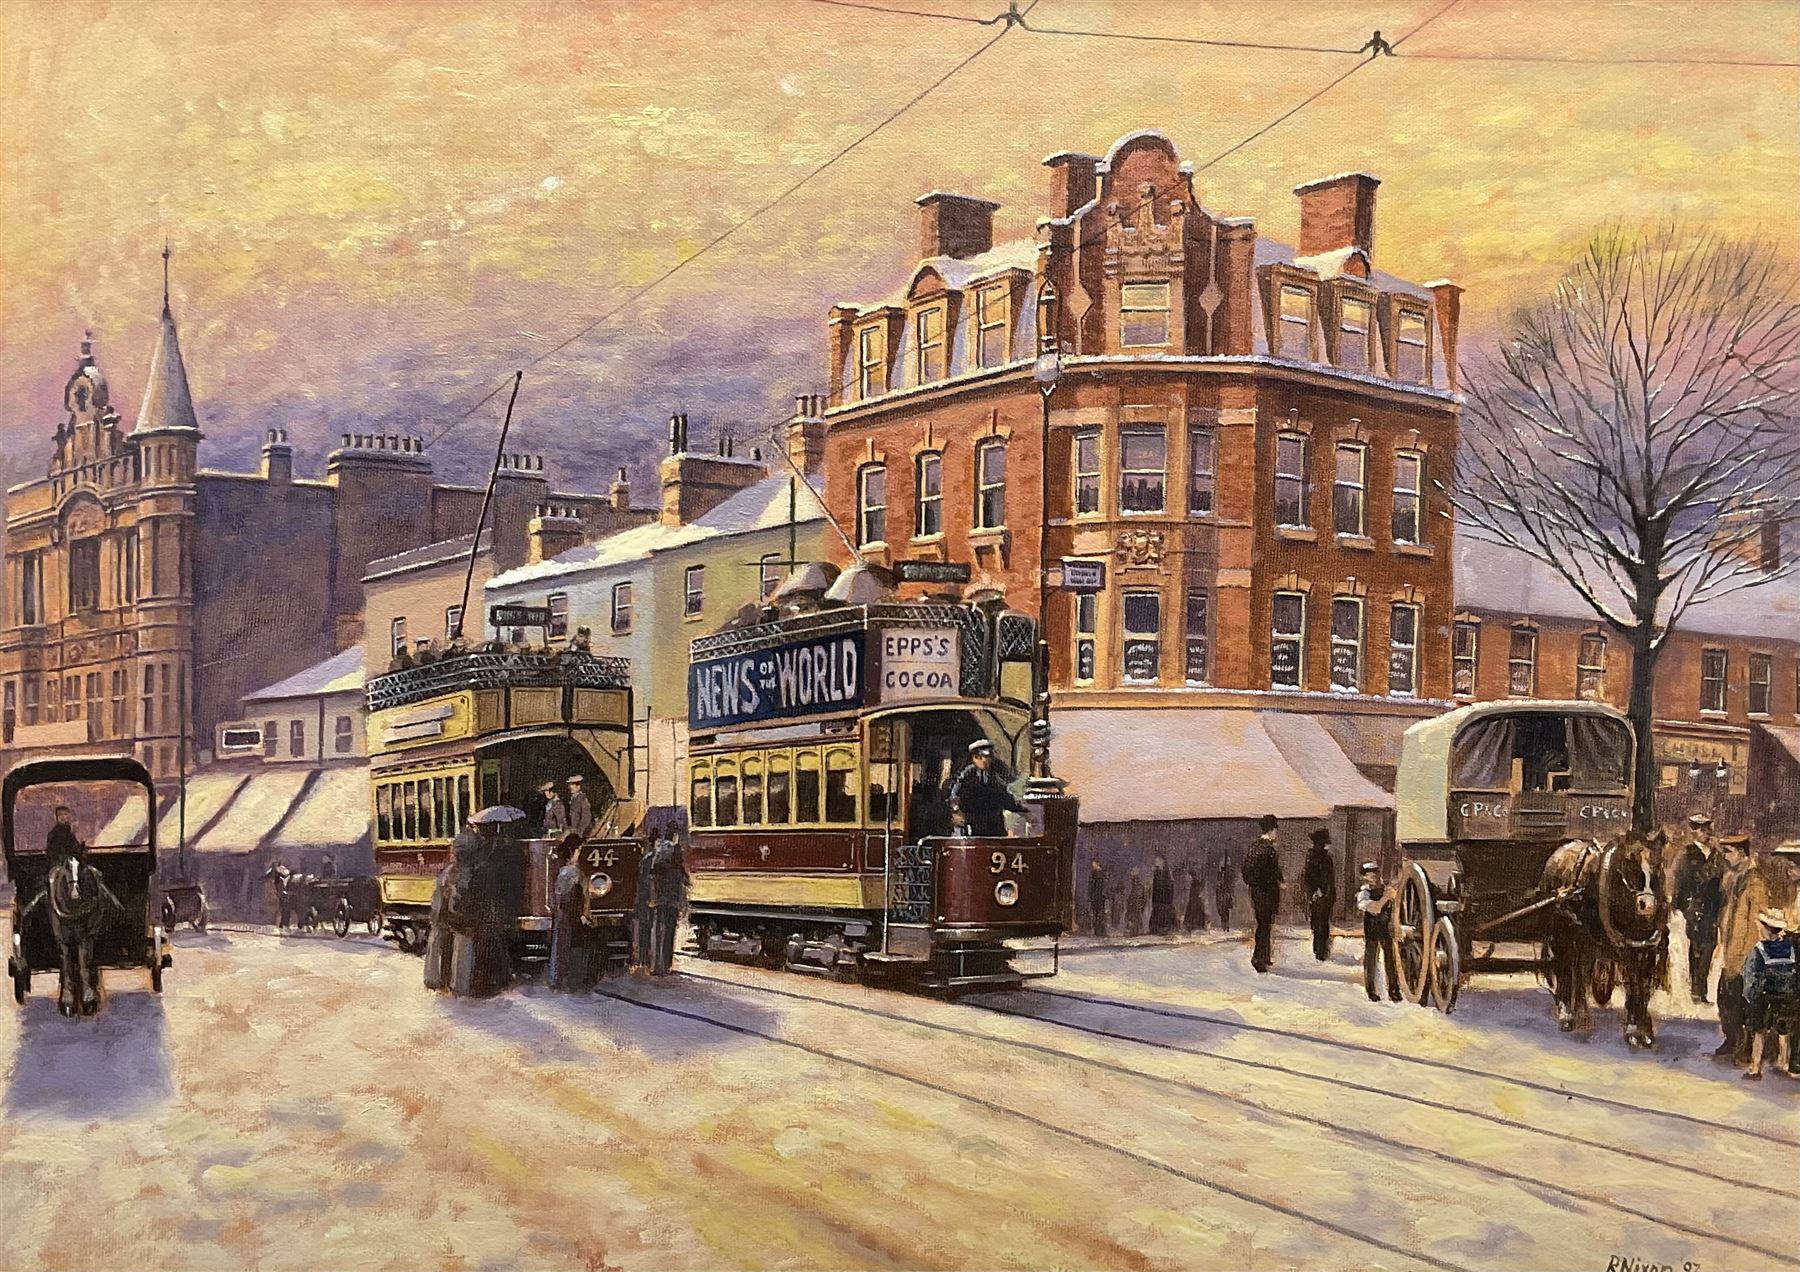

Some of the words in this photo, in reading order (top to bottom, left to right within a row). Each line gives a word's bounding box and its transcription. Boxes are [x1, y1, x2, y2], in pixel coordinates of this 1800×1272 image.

[885, 635, 951, 657] EPPS'S
[696, 658, 761, 720] NEWS
[759, 661, 775, 675] OF
[775, 638, 857, 708] WORLD
[885, 671, 953, 689] COCOA
[587, 848, 619, 867] 44
[990, 851, 1030, 874] 94
